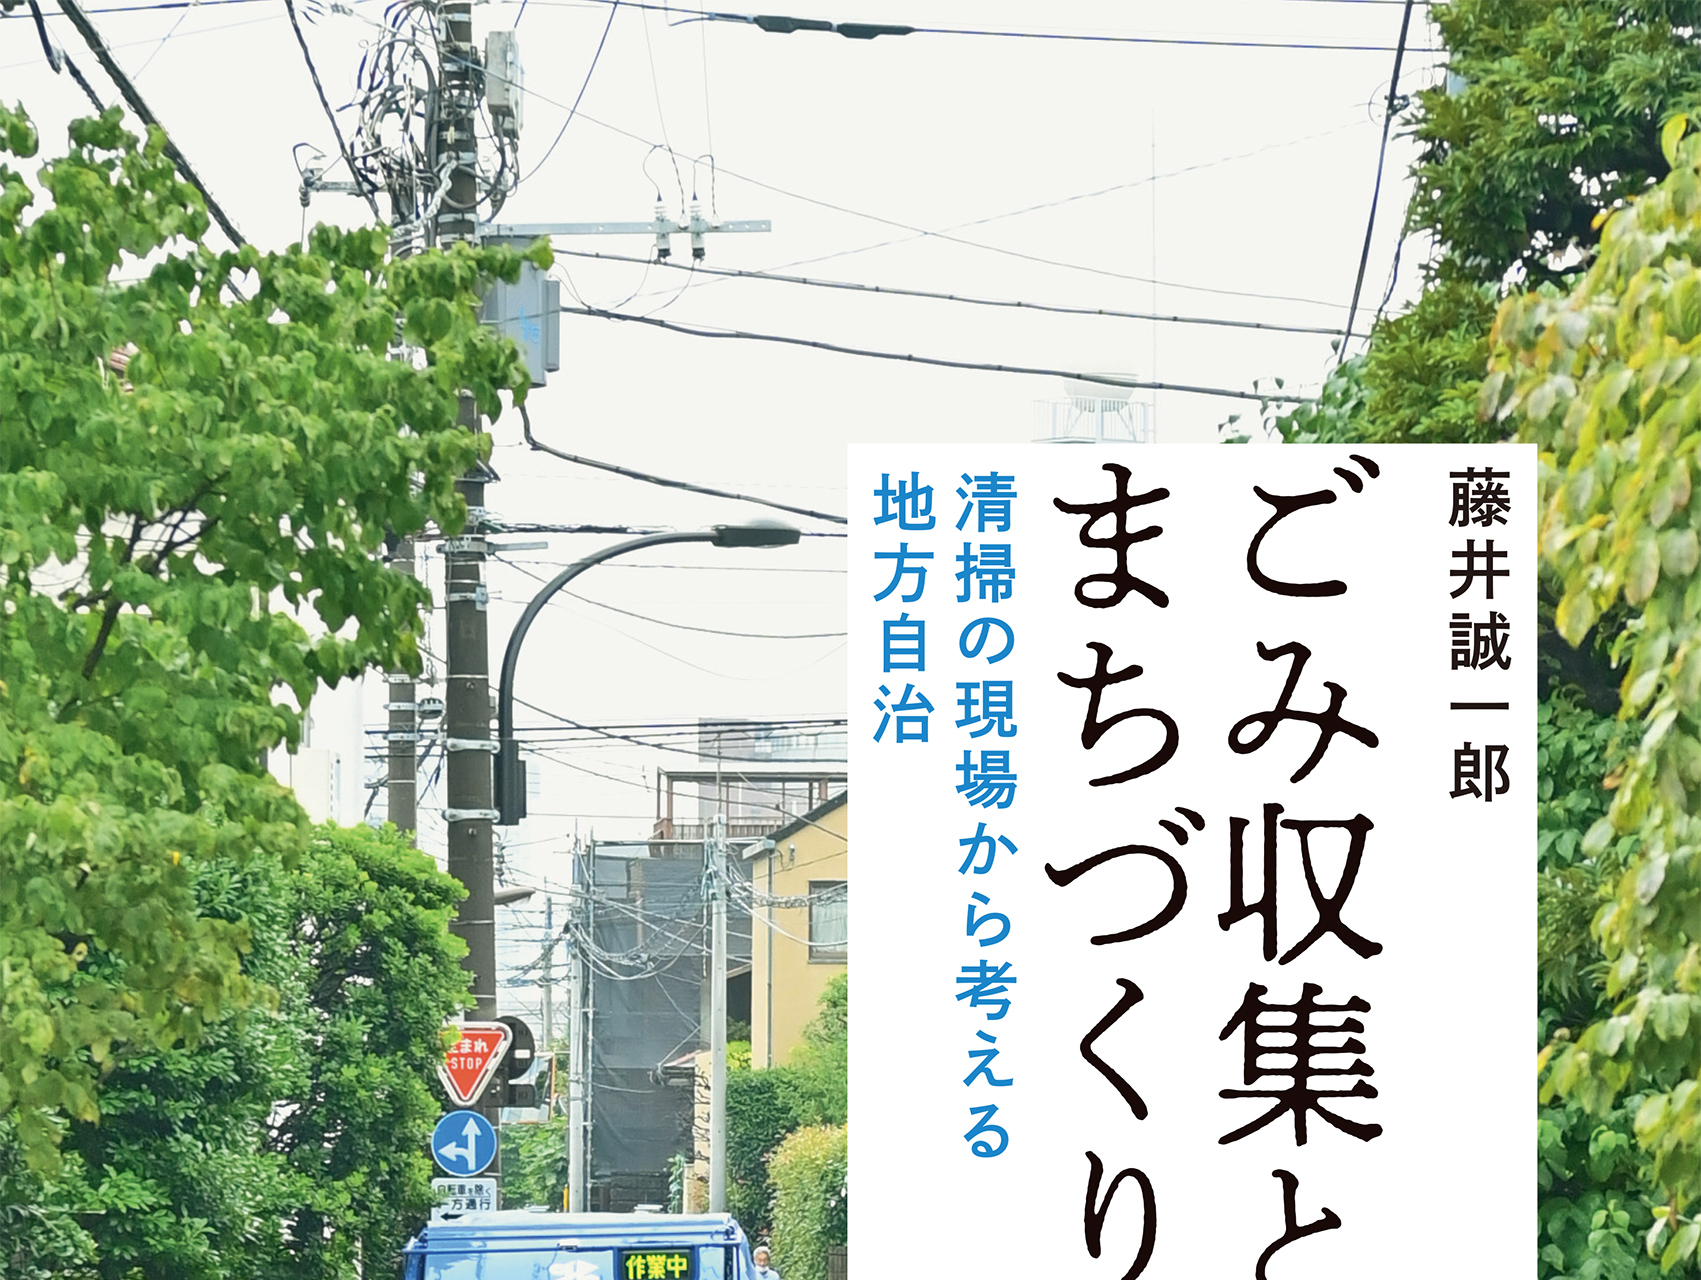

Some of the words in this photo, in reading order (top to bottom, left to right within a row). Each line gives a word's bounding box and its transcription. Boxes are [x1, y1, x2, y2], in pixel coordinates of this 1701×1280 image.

[450, 1057, 483, 1070] STOP
[625, 1254, 688, 1280] 作業中
